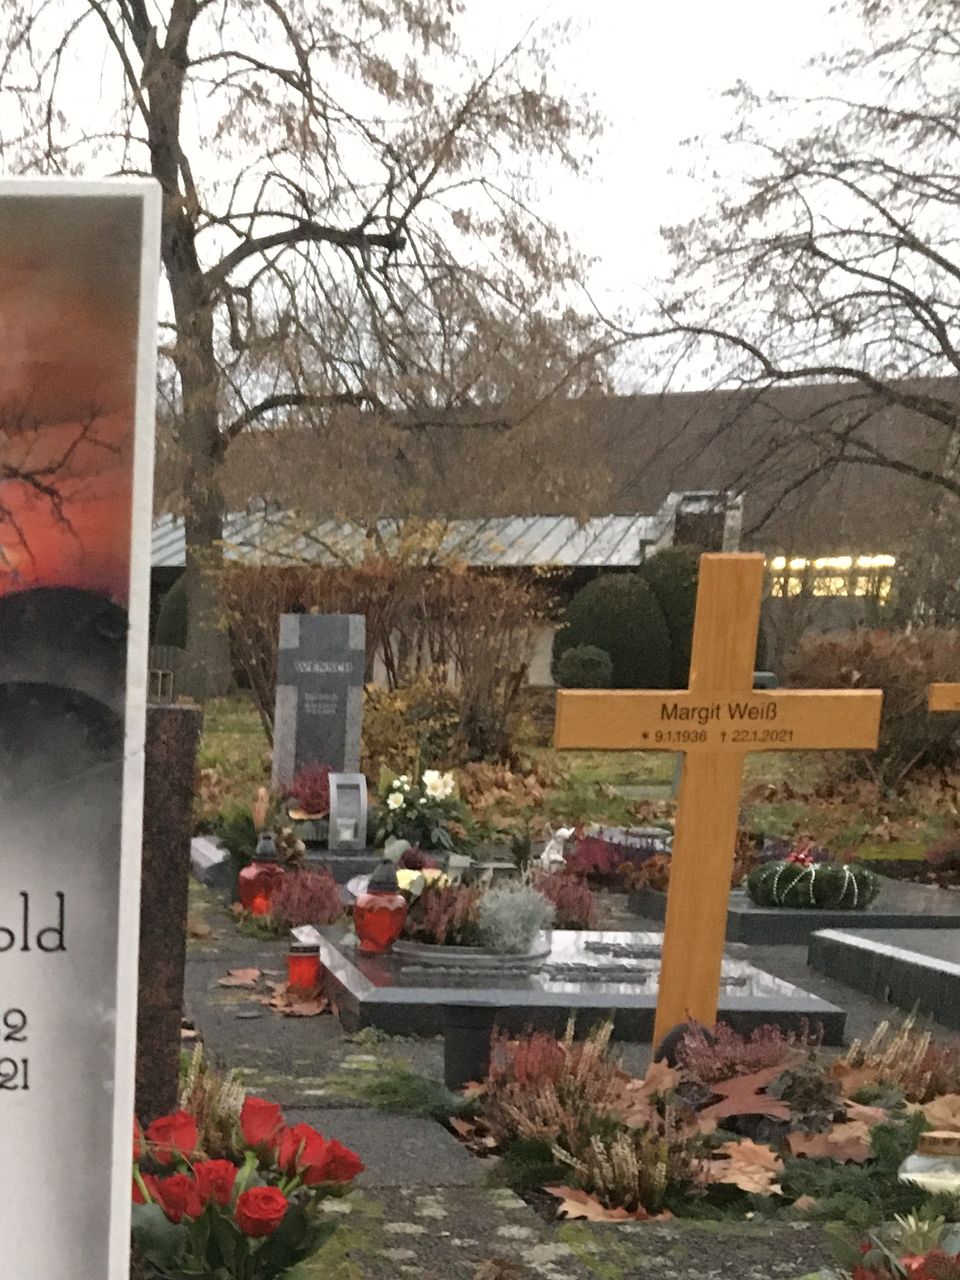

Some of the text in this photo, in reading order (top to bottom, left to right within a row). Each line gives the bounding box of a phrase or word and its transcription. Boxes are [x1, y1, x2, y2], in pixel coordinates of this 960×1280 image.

[660, 702, 778, 724] Margit Weiß
[655, 730, 794, 742] 9.1.1936 22.1.2021
